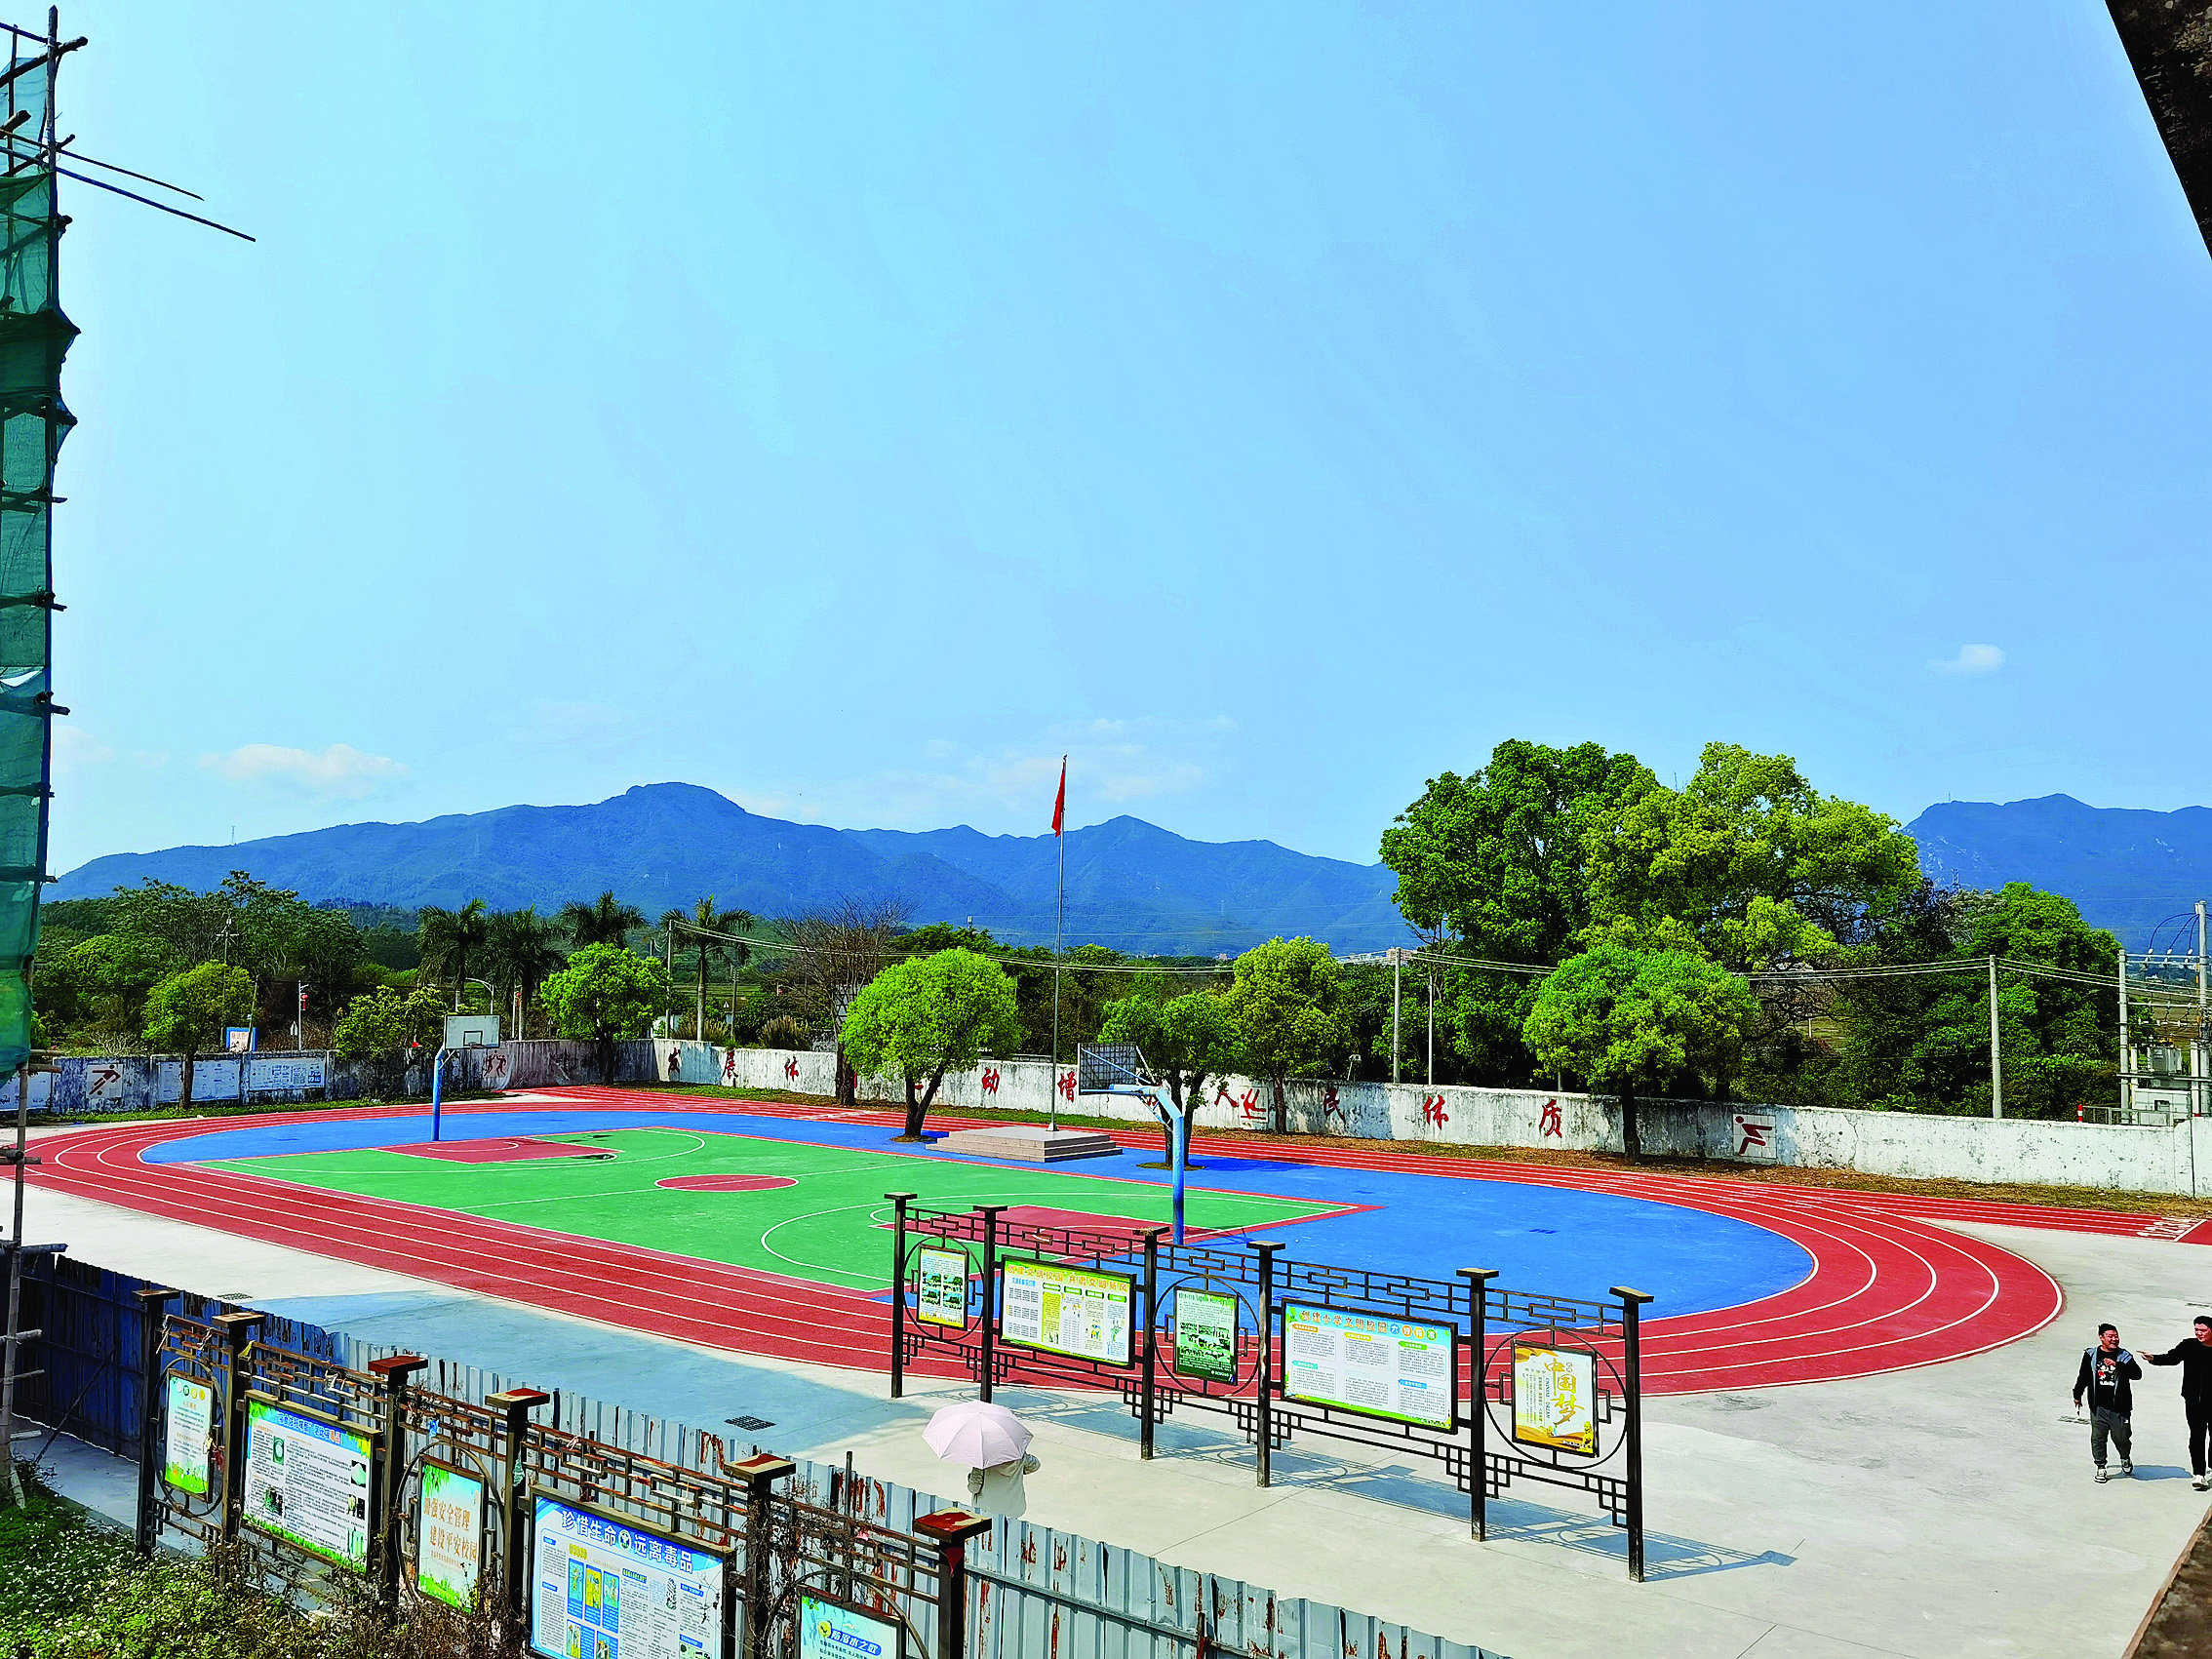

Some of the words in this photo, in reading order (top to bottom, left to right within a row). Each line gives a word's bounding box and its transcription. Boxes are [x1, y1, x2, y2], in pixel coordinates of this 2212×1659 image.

[1423, 1094, 1449, 1130] 体
[1538, 1098, 1562, 1138] 质
[1544, 1358, 1585, 1425] 中国梦
[430, 1524, 478, 1562] 建设平安校园
[562, 1510, 617, 1547] 珍惜生命
[634, 1534, 693, 1574] 远离毒品
